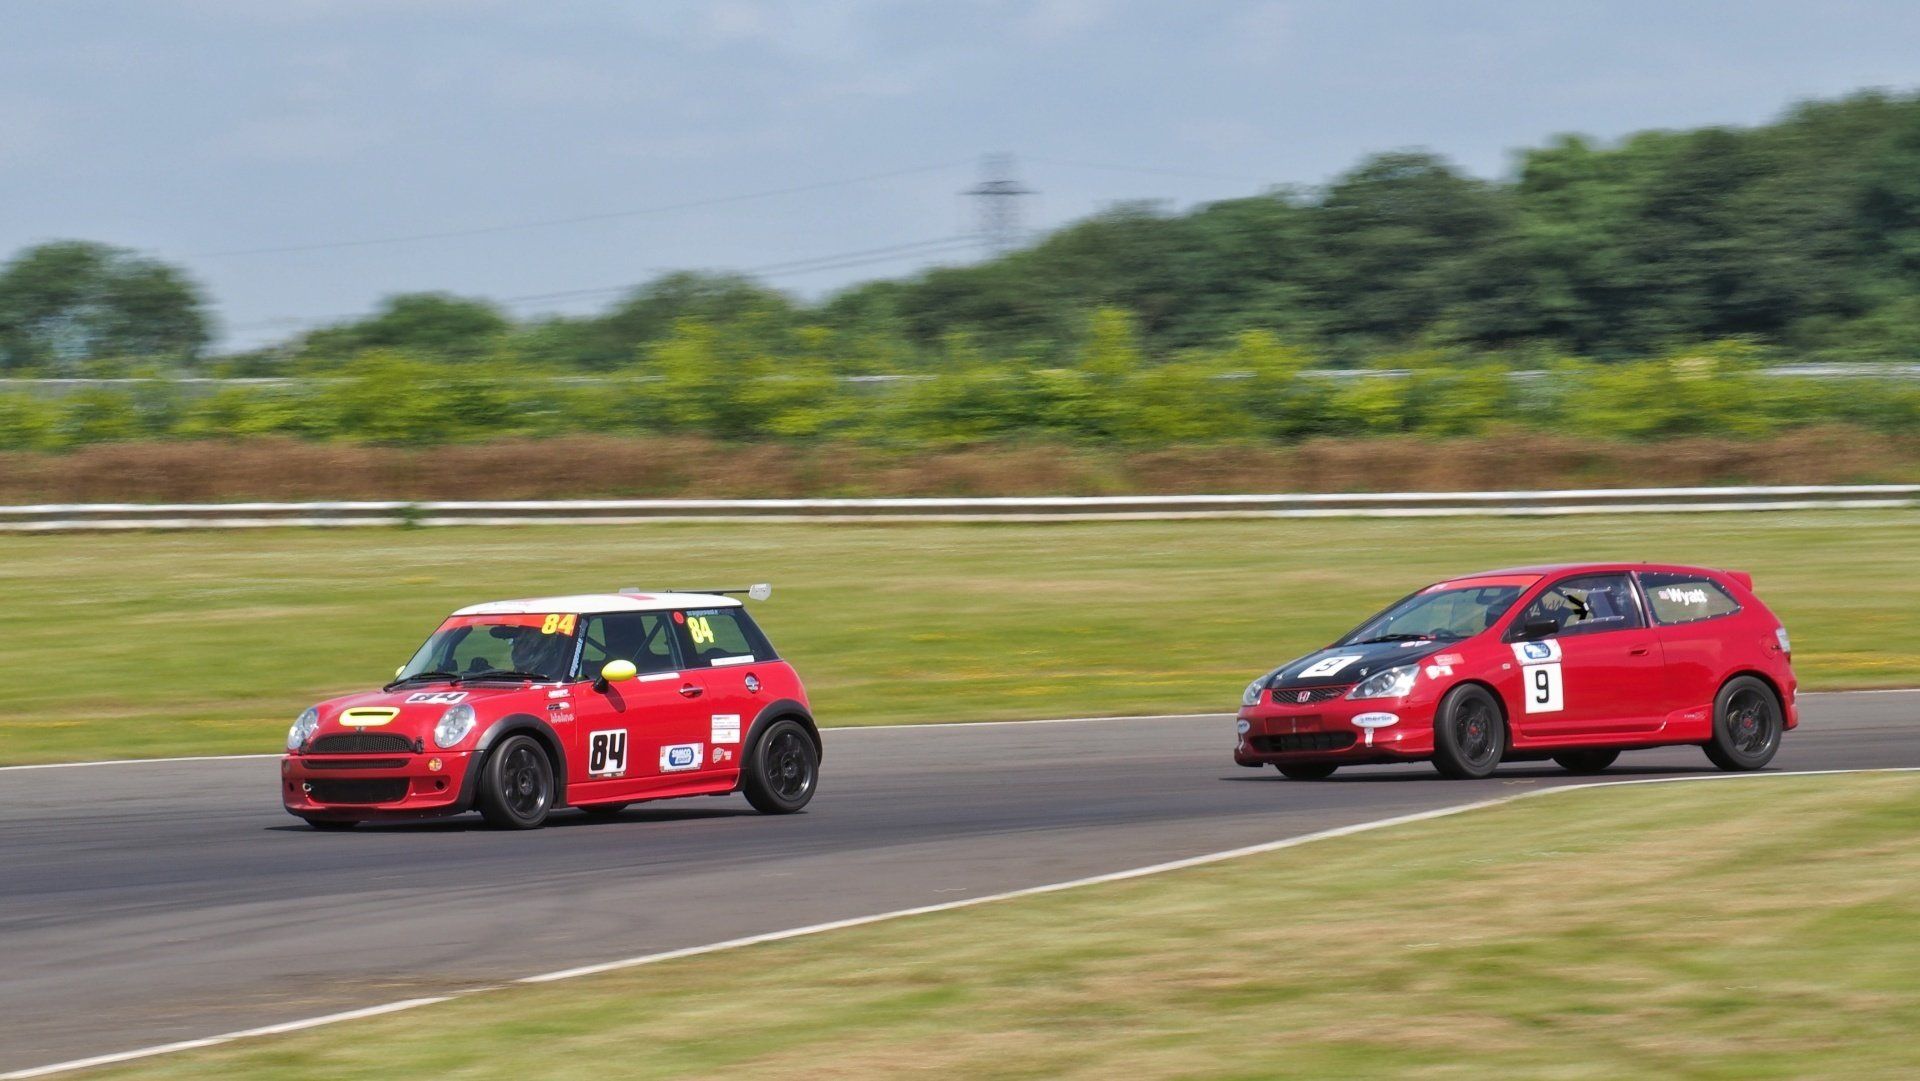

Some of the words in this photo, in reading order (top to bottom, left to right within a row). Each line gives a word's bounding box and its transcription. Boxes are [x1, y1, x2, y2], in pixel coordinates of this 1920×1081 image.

[1667, 588, 1707, 606] Wyatt
[542, 614, 574, 636] 84
[687, 616, 714, 643] 84
[1535, 670, 1549, 703] 9
[591, 733, 625, 771] 84
